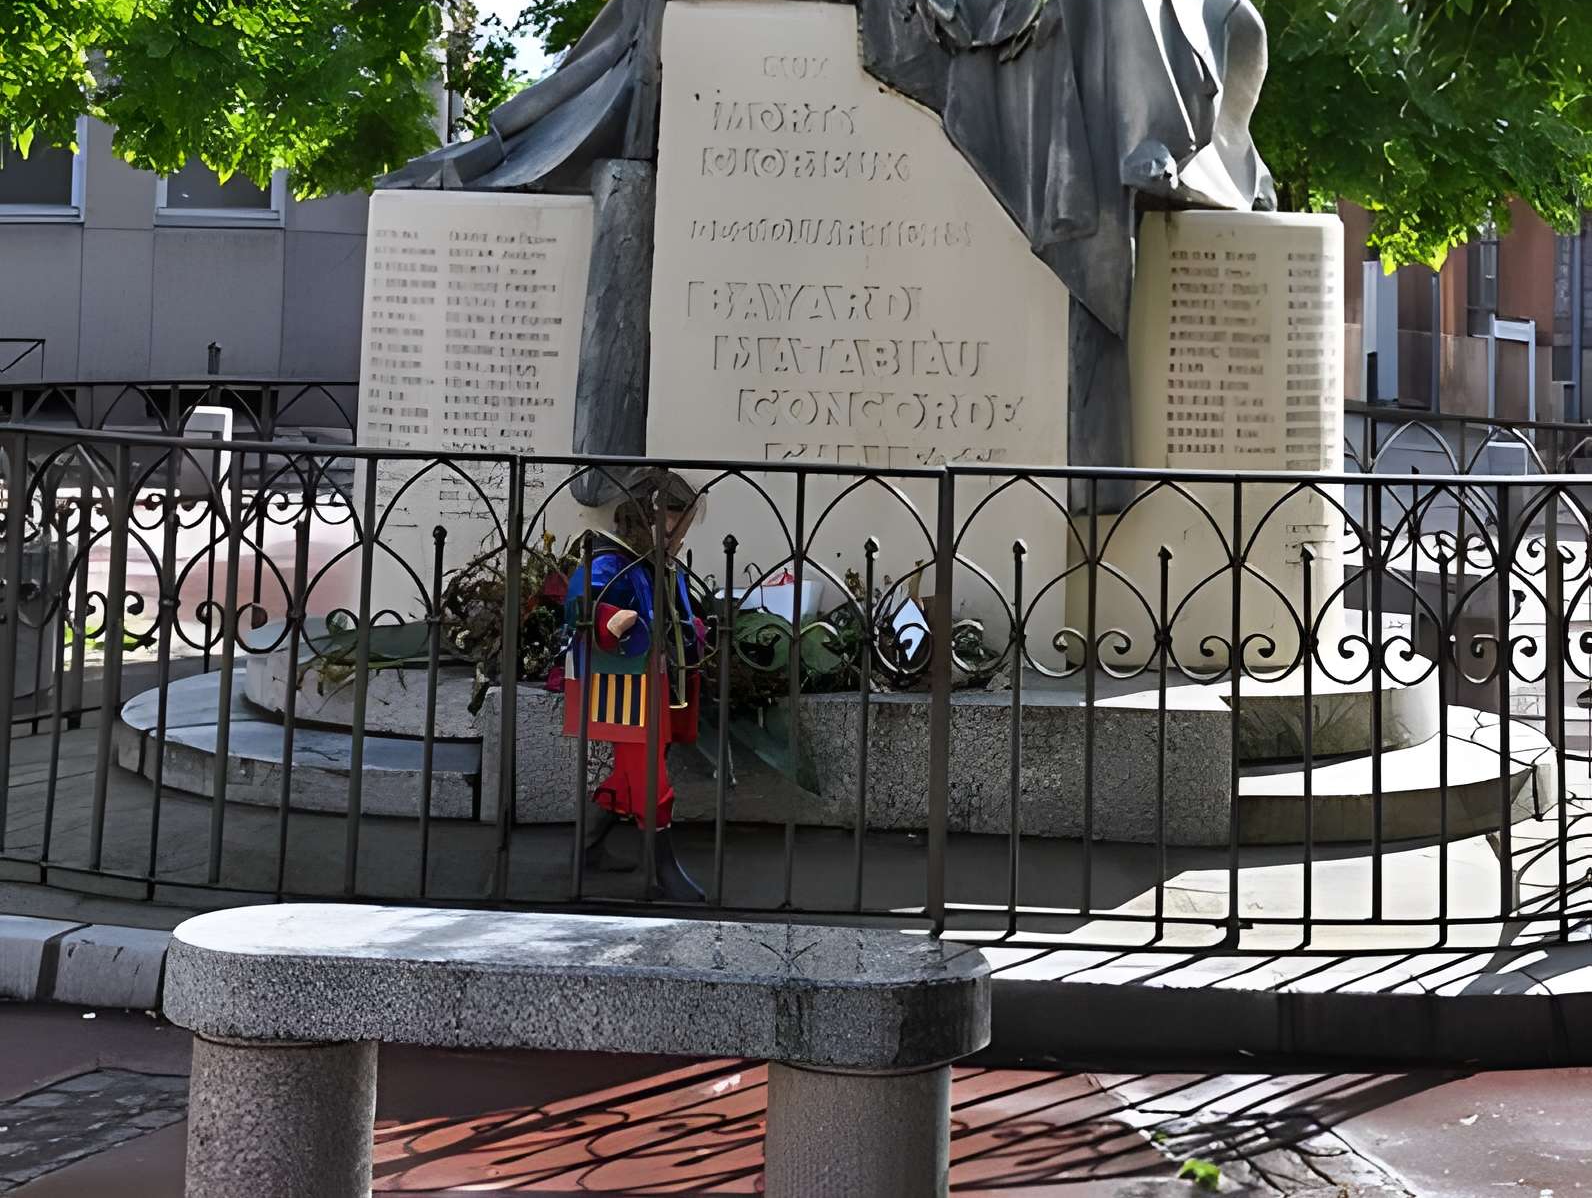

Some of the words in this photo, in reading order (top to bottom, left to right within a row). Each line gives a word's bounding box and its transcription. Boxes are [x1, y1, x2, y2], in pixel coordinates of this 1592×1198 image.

[686, 279, 923, 322] BAYARD
[712, 334, 991, 378] MATABIAU
[736, 388, 1026, 432] CONCORDE
